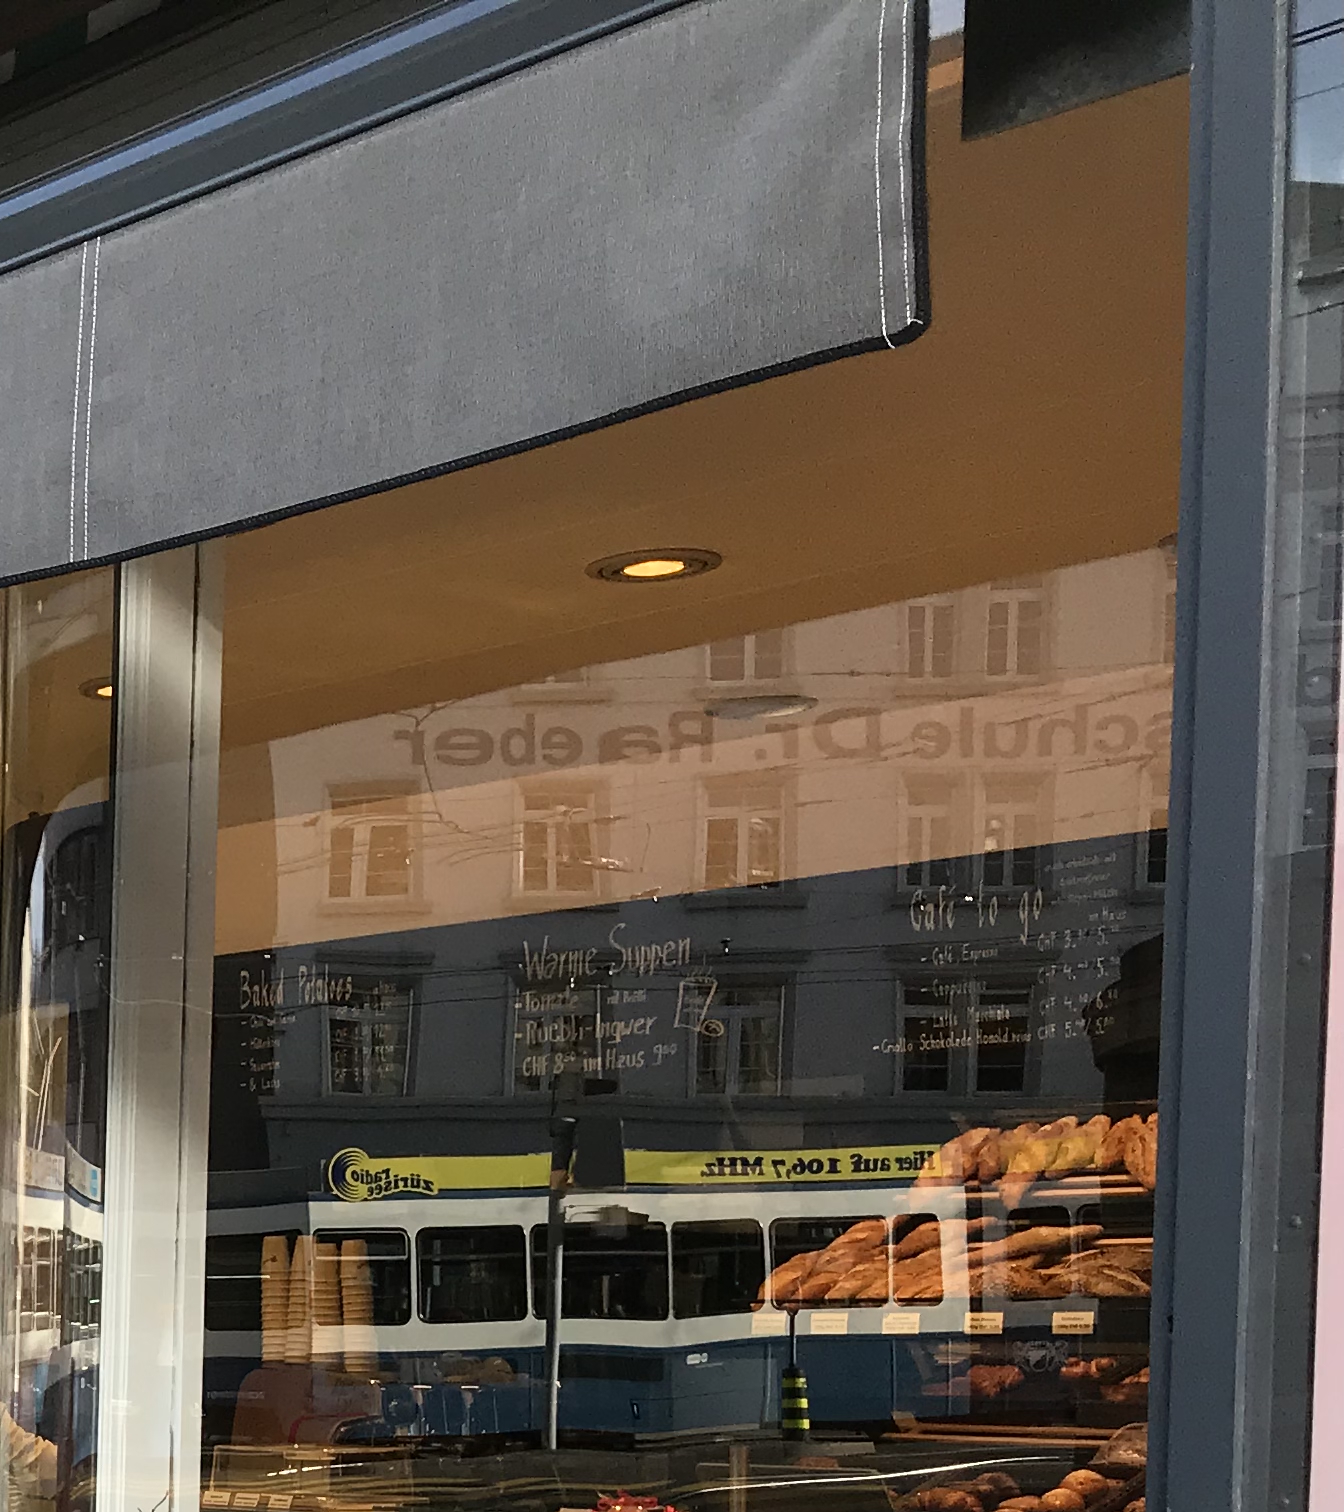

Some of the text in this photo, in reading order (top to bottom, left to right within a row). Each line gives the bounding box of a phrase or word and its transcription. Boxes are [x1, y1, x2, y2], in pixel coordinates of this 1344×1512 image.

[910, 884, 956, 932] Café
[978, 880, 998, 928] to
[1019, 888, 1043, 946] go
[523, 923, 691, 981] Warme Suppen
[240, 967, 285, 1010] Baked
[522, 1053, 551, 1077] CHF
